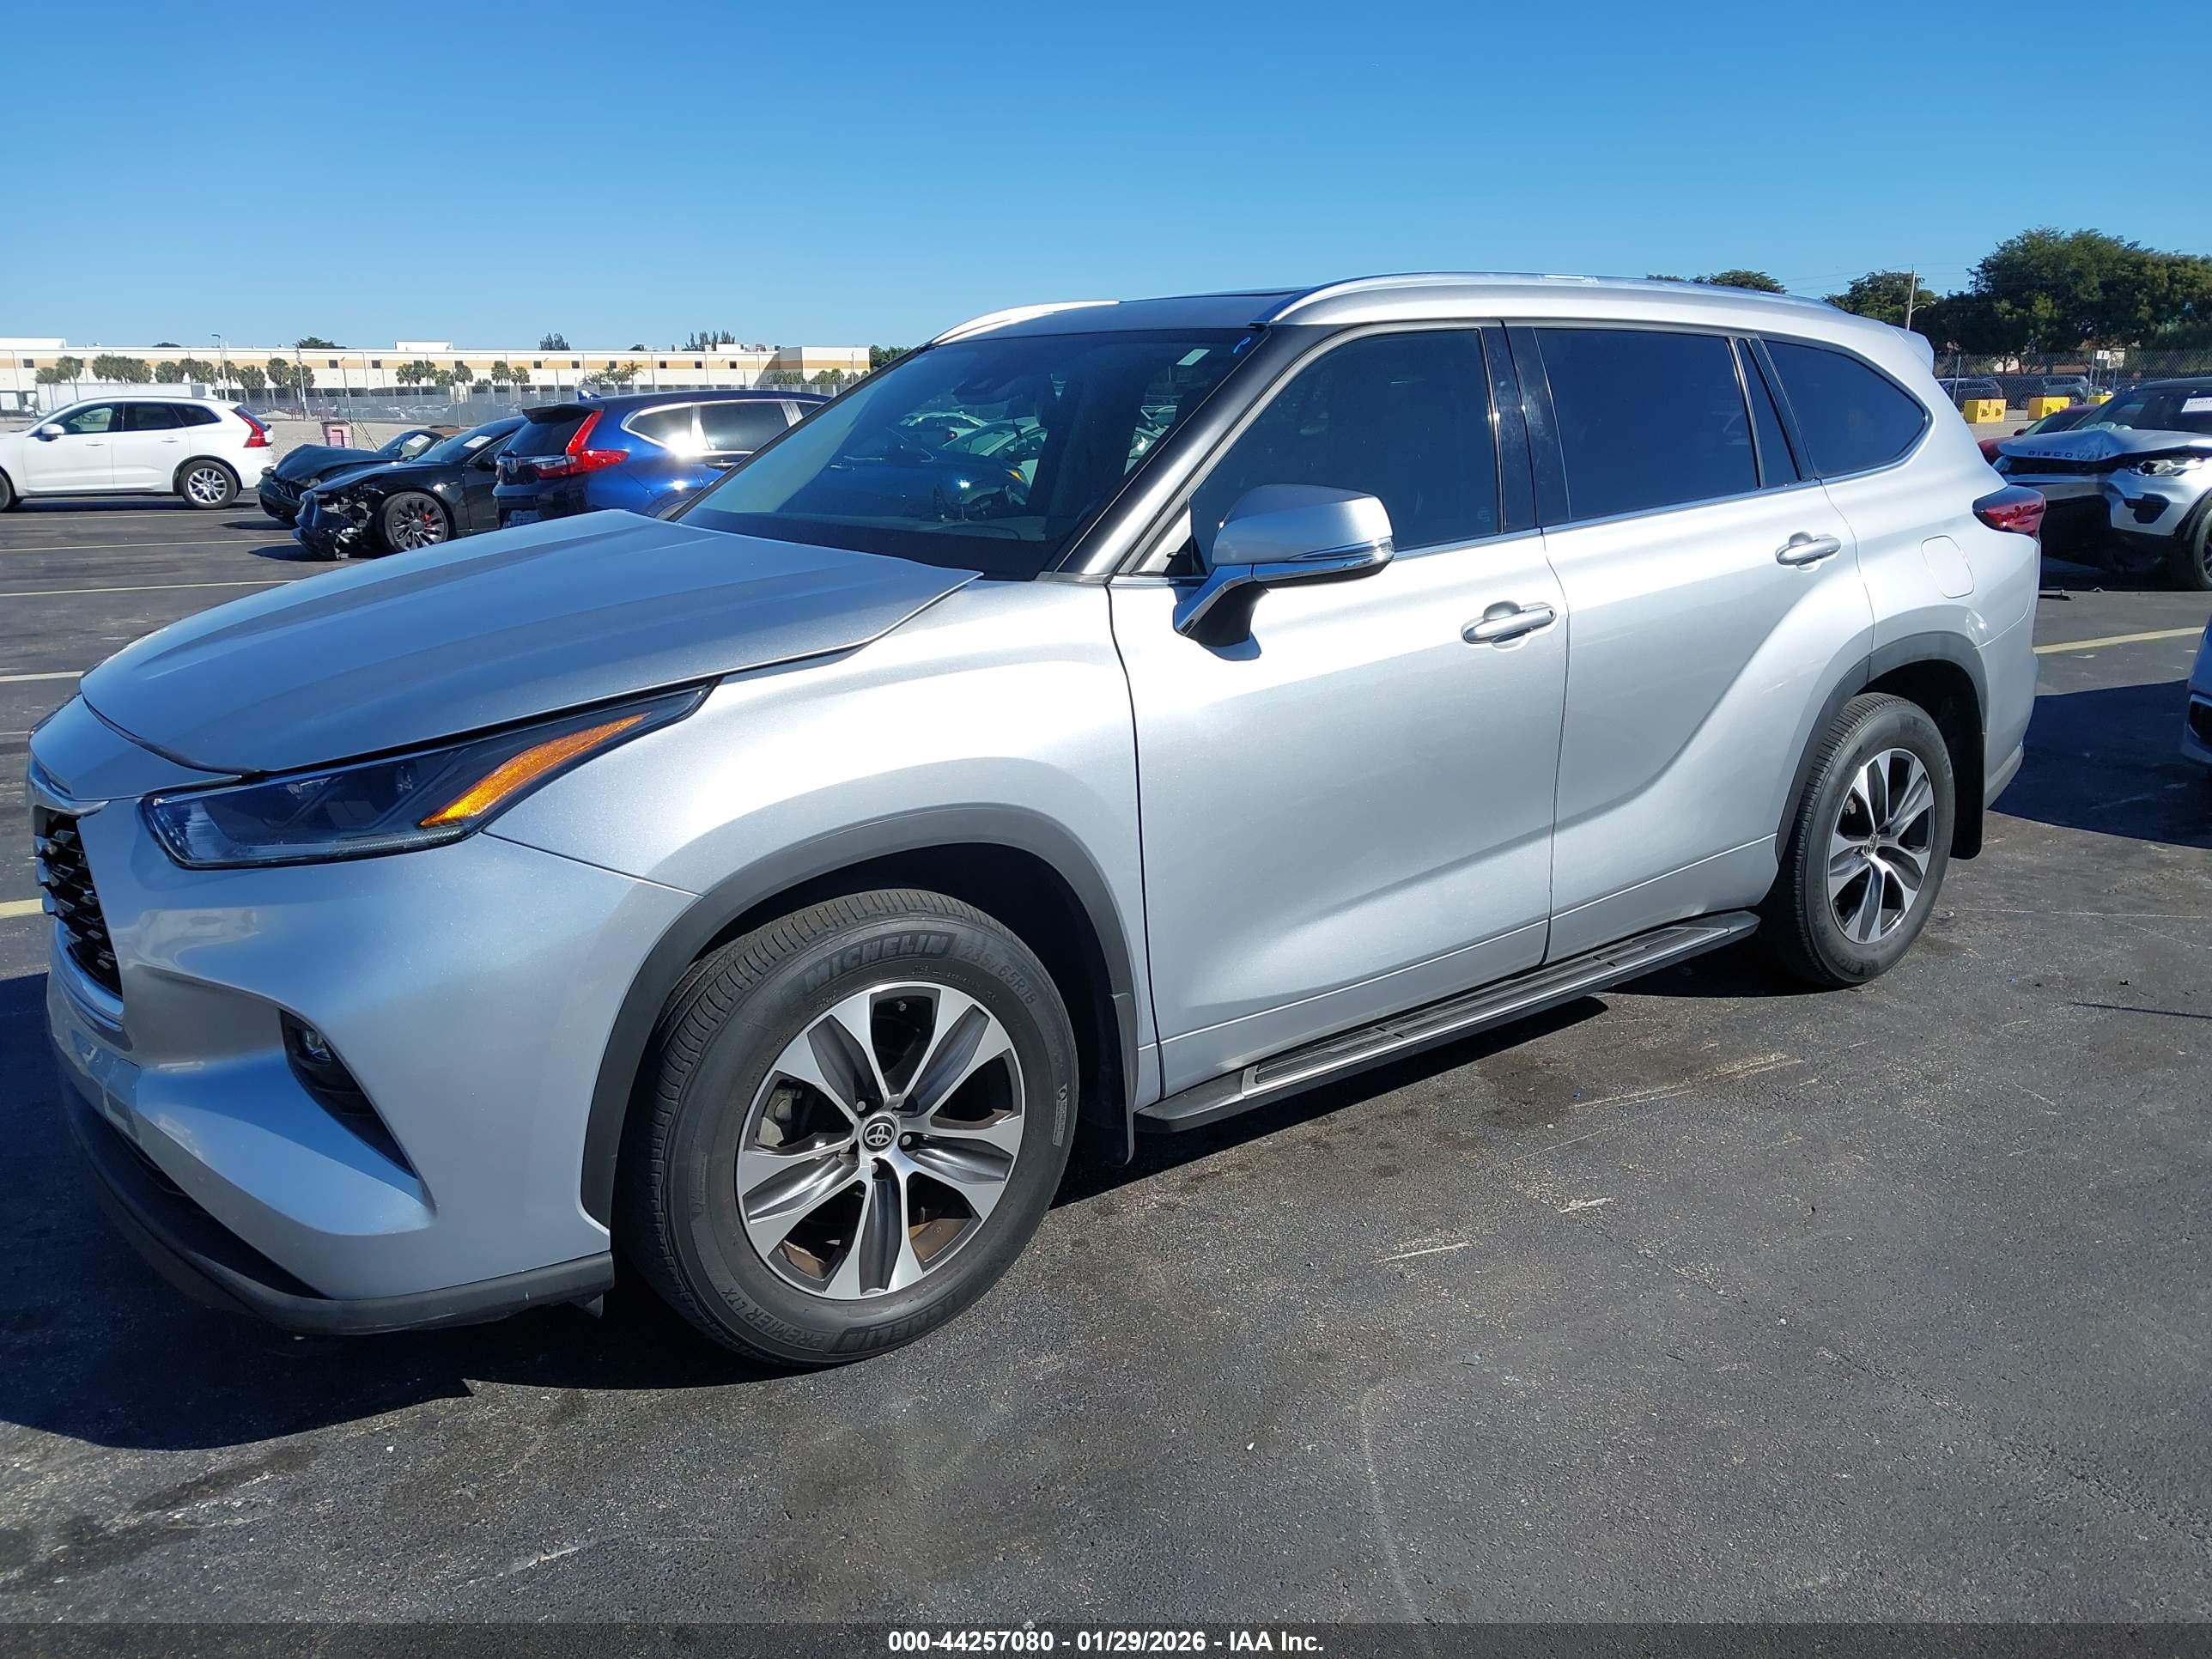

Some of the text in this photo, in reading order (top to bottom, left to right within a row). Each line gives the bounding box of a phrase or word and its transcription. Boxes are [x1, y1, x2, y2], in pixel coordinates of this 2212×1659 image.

[805, 934, 950, 990] MICHELIN
[960, 945, 1038, 1004] 235/65R18
[720, 1288, 823, 1347] PREMIER LTX
